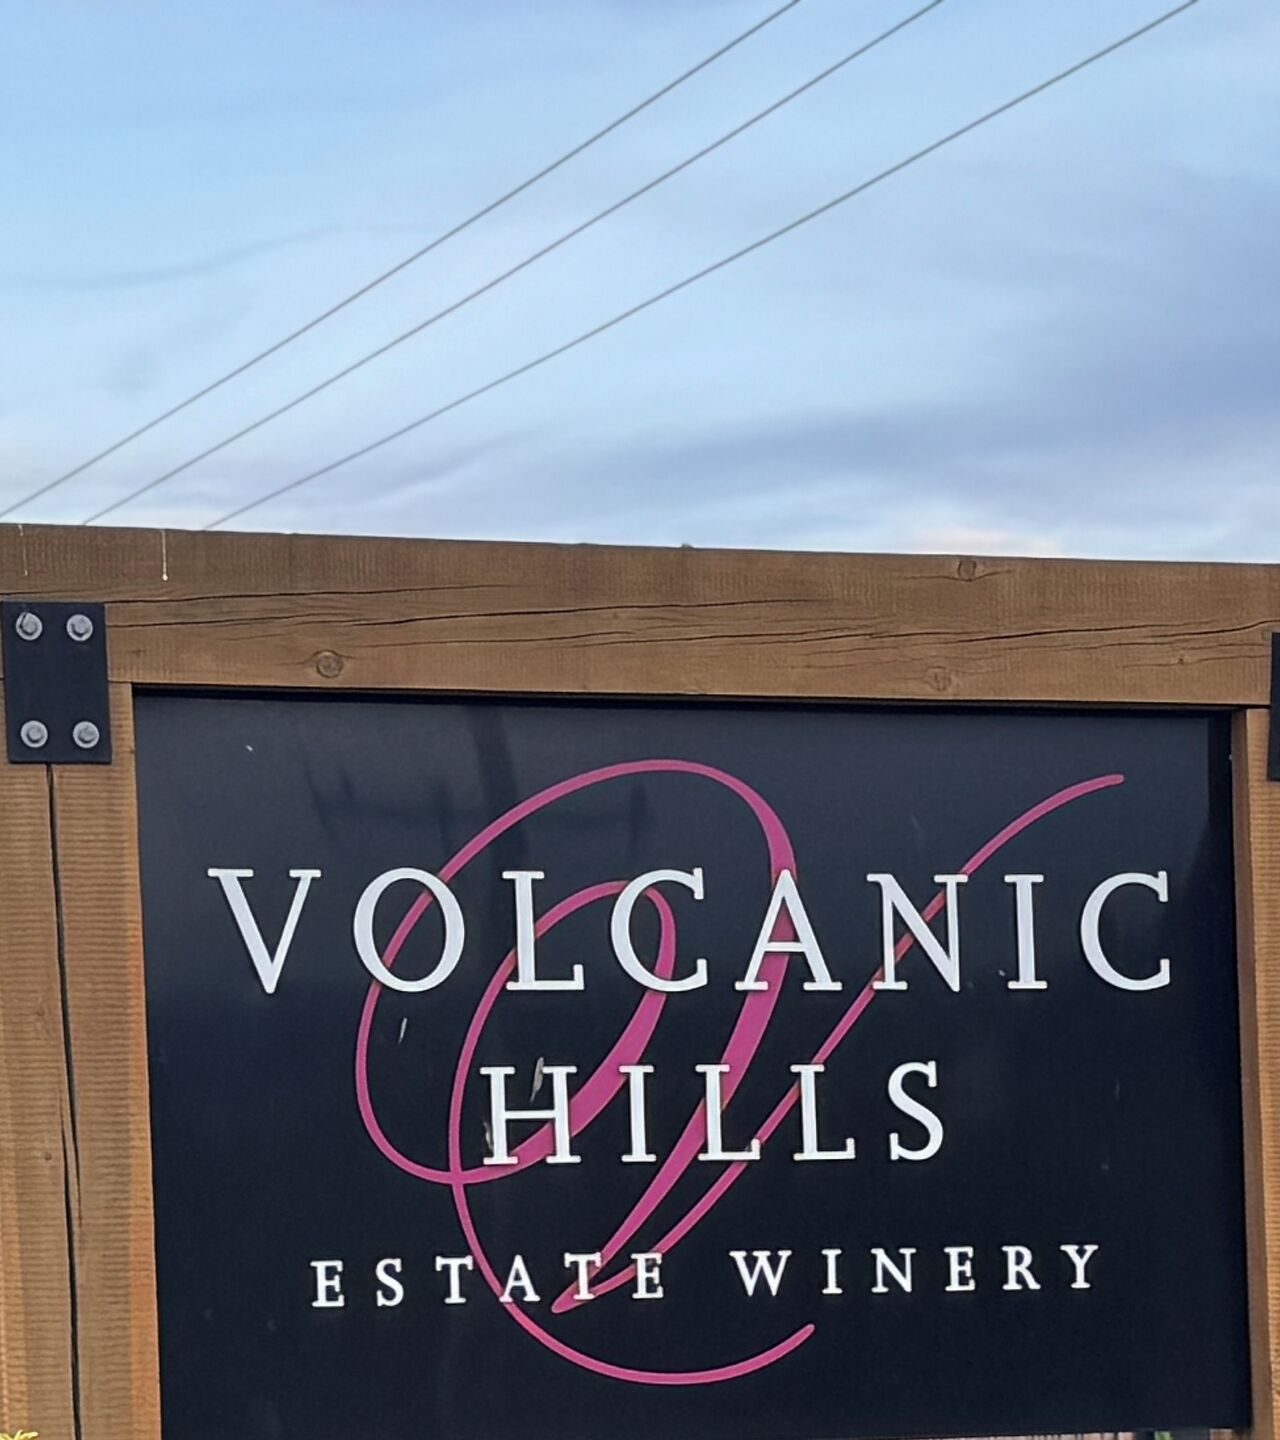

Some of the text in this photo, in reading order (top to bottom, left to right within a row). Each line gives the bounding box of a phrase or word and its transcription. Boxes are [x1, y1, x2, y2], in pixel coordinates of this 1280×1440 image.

[207, 867, 1170, 994] VOLCANIC
[480, 1060, 944, 1165] HILLS
[310, 1244, 1099, 1308] ESTATE WINERY
